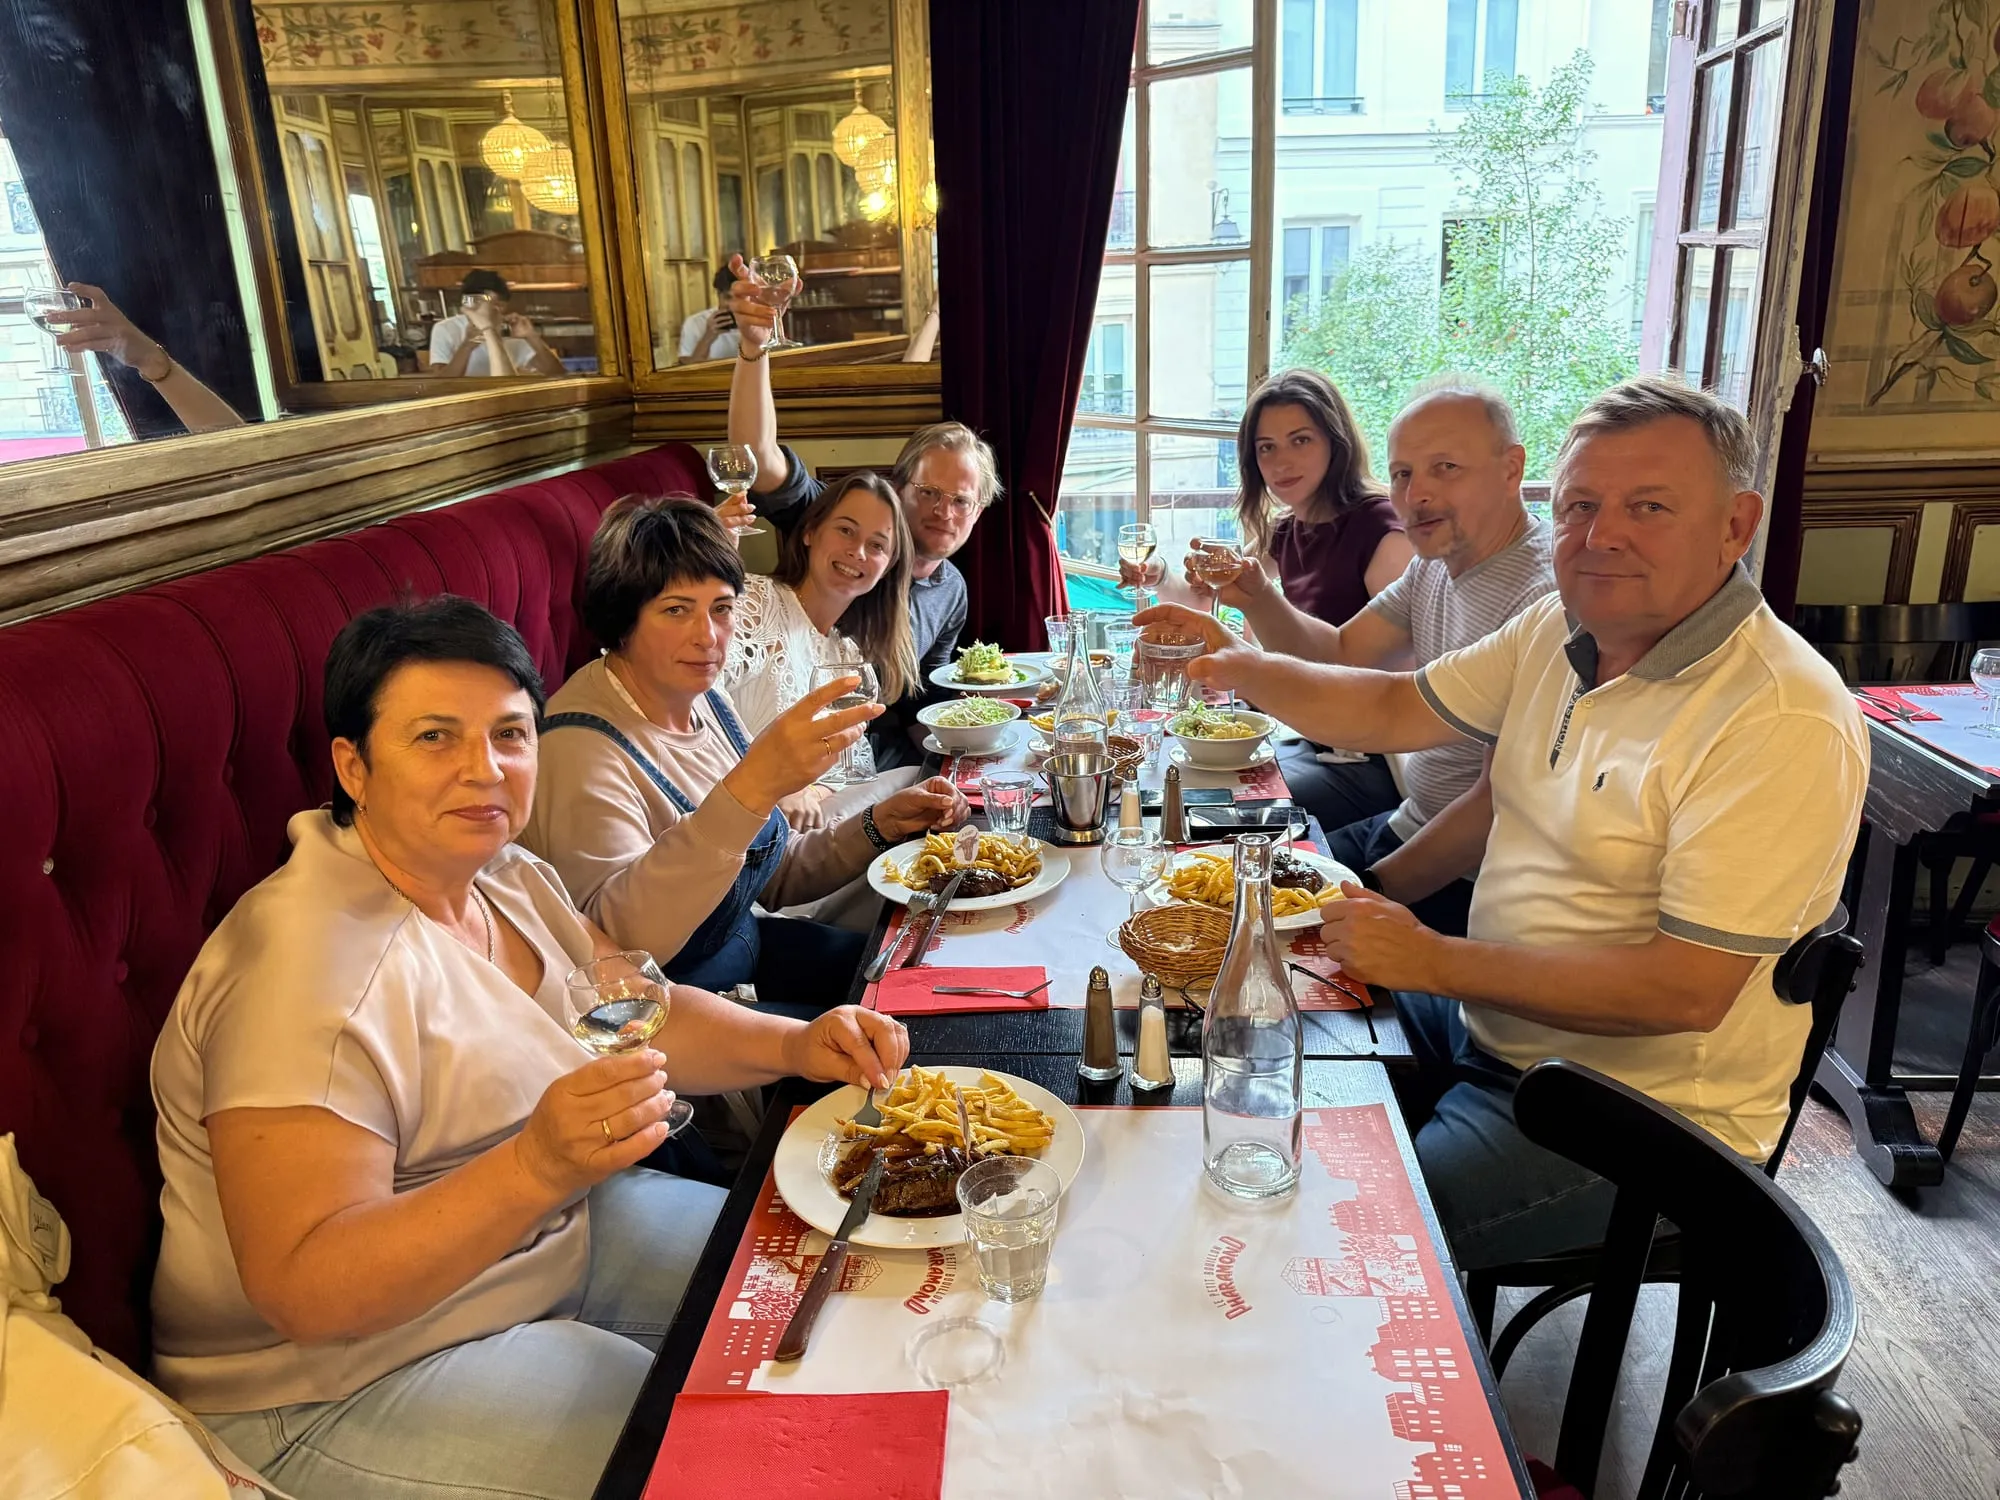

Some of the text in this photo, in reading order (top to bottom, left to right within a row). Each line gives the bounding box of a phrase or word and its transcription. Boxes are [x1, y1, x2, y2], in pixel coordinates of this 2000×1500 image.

[945, 1252, 957, 1270] PETIT
[1203, 1245, 1226, 1308] LE PETIT BOUILLON
[1215, 1235, 1253, 1320] PHARAMOND
[929, 1273, 956, 1305] BOUILLON
